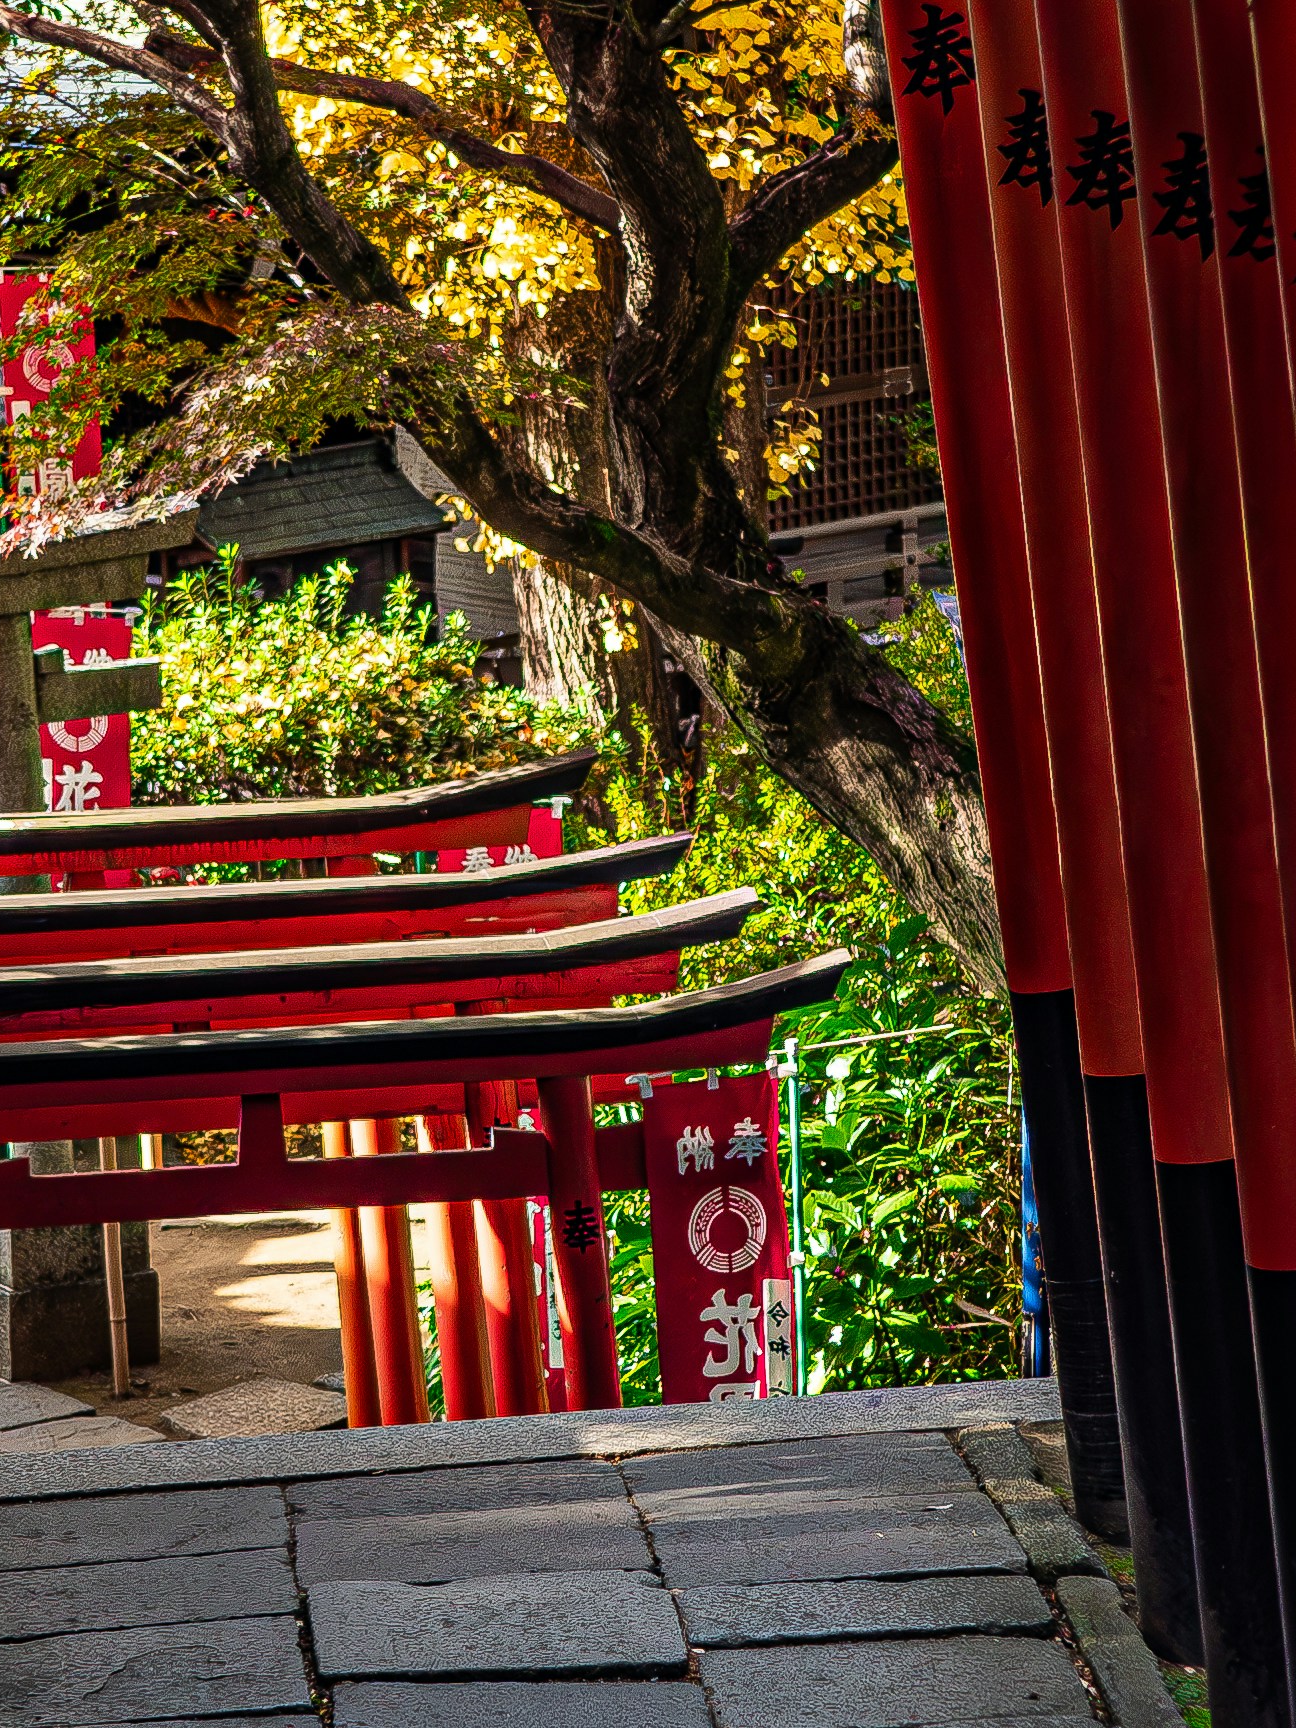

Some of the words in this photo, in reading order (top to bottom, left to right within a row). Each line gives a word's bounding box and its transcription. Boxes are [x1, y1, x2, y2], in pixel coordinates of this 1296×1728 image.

[901, 3, 976, 117] 奉
[1064, 110, 1138, 232] 奉
[562, 1200, 601, 1254] 奉
